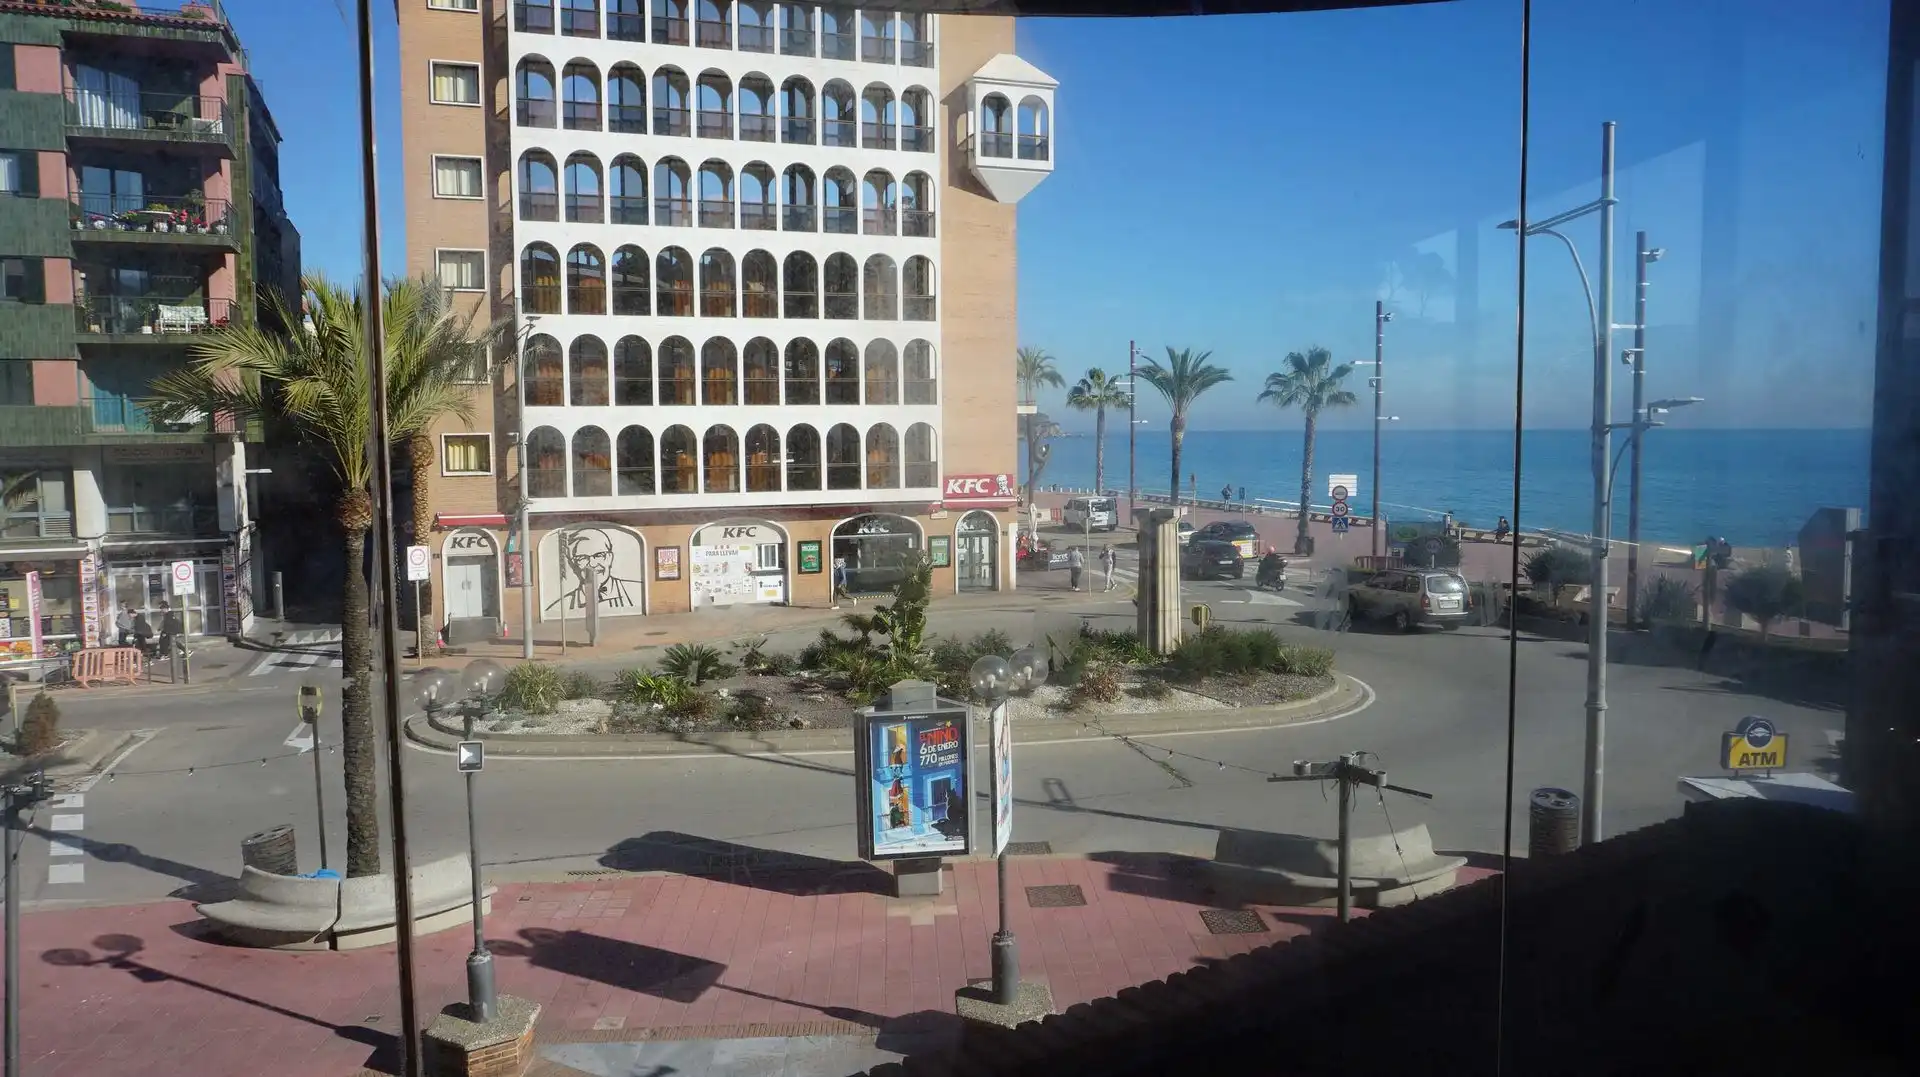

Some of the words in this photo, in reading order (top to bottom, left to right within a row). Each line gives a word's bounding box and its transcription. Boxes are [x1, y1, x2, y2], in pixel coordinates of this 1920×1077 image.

[945, 478, 991, 494] KFC
[722, 526, 757, 539] KFC
[450, 535, 489, 549] KFC
[919, 742, 928, 755] 6
[928, 744, 937, 754] DE
[937, 740, 959, 752] ENERO
[919, 753, 938, 767] 770
[1738, 751, 1777, 766] ATM
